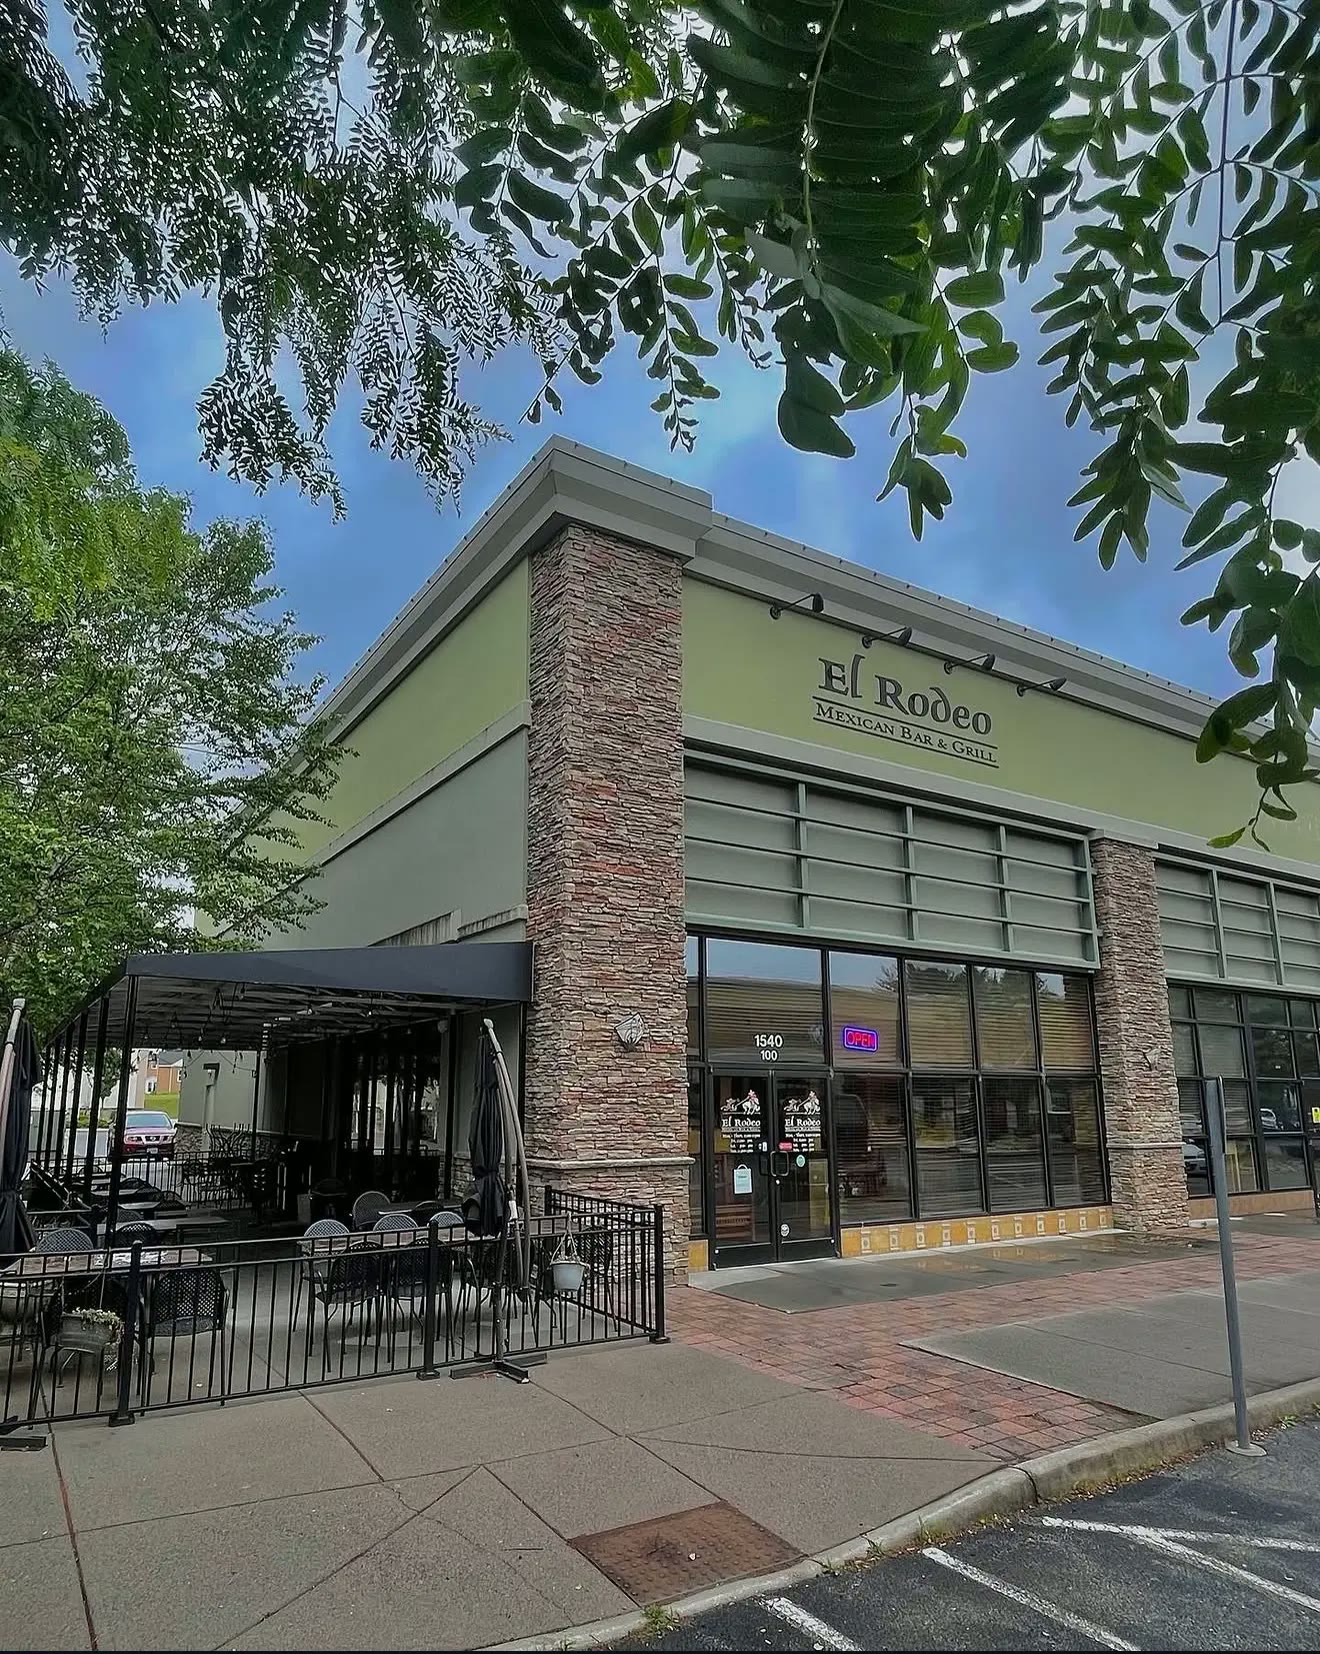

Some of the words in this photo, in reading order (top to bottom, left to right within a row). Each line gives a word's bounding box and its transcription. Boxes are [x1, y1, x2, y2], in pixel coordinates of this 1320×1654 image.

[818, 653, 866, 699] El
[874, 674, 992, 736] Rodeo
[815, 702, 895, 736] MEXICAN
[899, 725, 934, 747] BAR
[936, 738, 948, 750] &
[952, 740, 998, 763] GRILL
[754, 1034, 783, 1048] 1540
[846, 1030, 876, 1049] OPEN
[760, 1049, 778, 1061] 100
[721, 1115, 732, 1127] El
[734, 1117, 761, 1127] Rodeo
[784, 1115, 795, 1127] El
[796, 1117, 821, 1127] Rodeo
